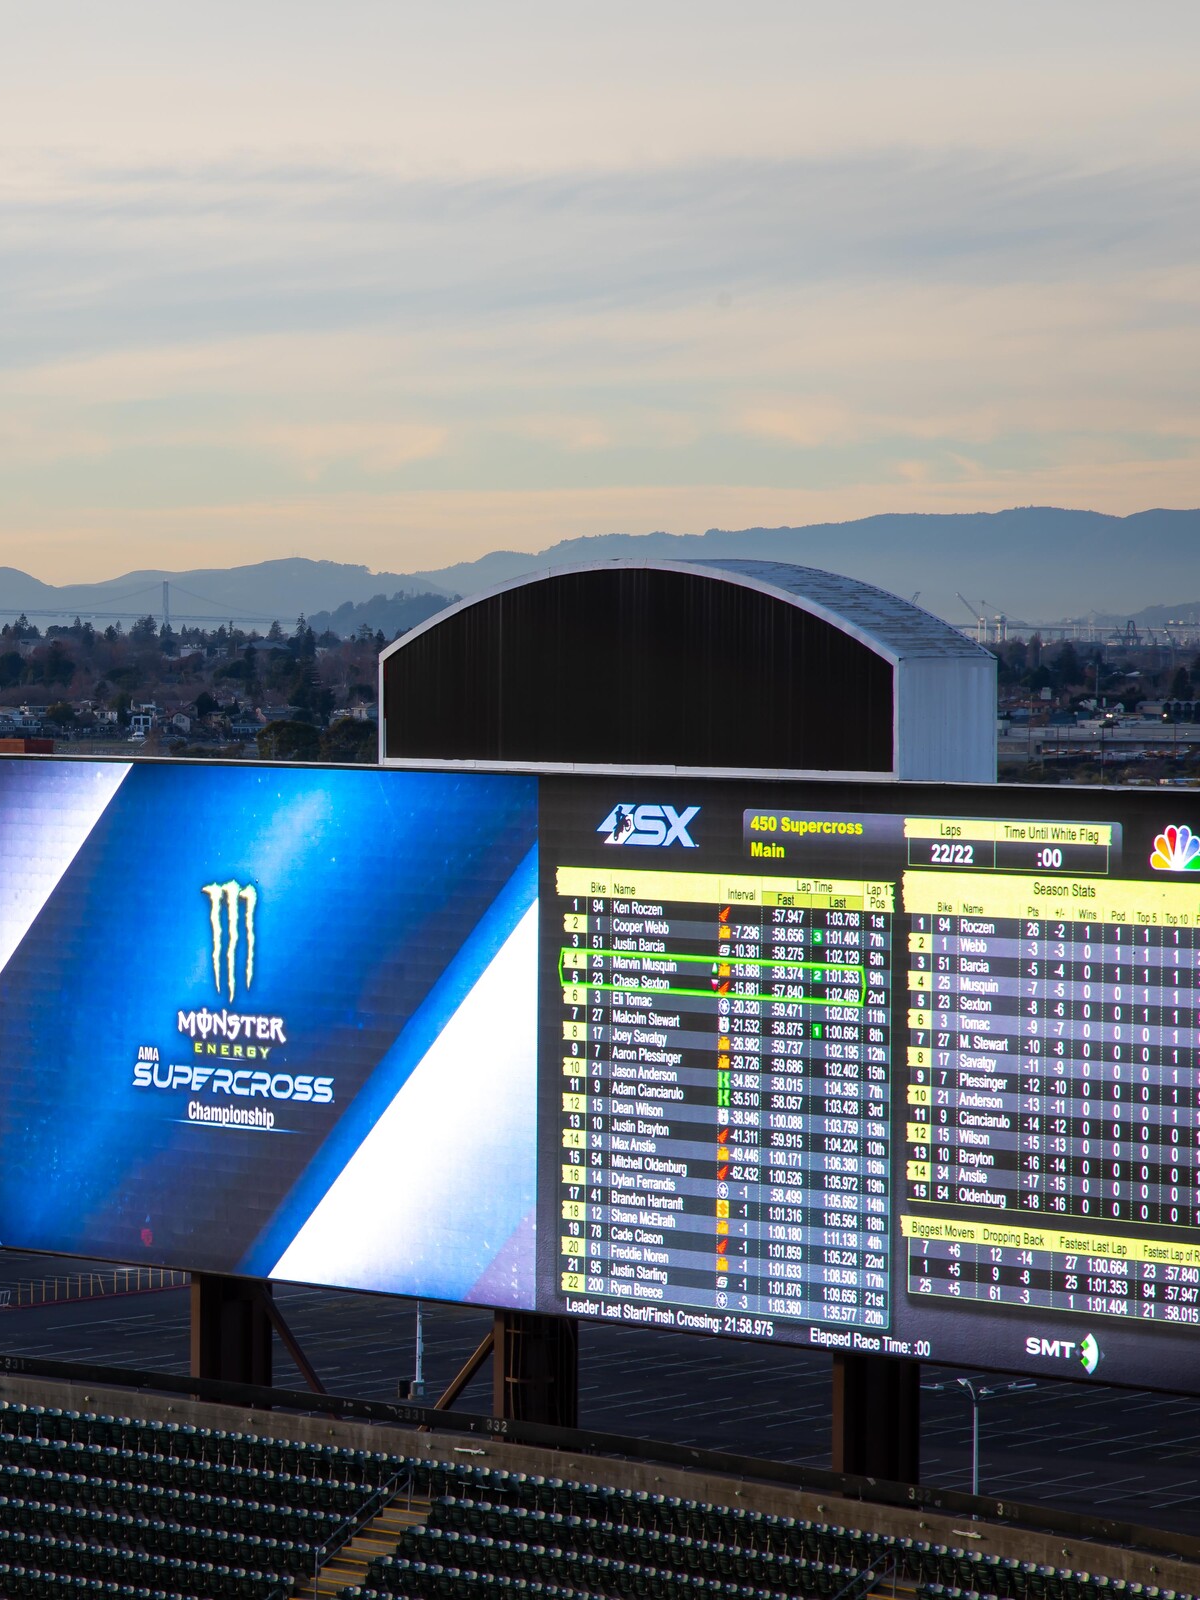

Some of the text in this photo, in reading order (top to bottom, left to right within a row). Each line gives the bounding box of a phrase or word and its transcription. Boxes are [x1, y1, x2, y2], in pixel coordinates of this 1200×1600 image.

[751, 816, 863, 835] 450 Supercross
[941, 823, 961, 838] Laps
[1005, 826, 1099, 844] Time Until White Flag
[751, 842, 785, 858] Main
[931, 844, 973, 863] 22/22
[1037, 849, 1062, 867] :00
[591, 882, 606, 894] Bike
[614, 883, 636, 895] Name
[728, 888, 755, 901] Interval
[797, 880, 832, 894] Lap Time
[867, 884, 881, 896] Lap
[1034, 882, 1096, 897] Season Stats
[614, 901, 662, 915] Ken Roczen
[777, 894, 794, 906] Fast
[829, 896, 846, 908] Last
[870, 897, 885, 909] Pos
[938, 902, 952, 913] Bike
[773, 909, 804, 923] :57.947
[963, 904, 983, 914] Name
[1028, 907, 1039, 917] Pts
[1079, 909, 1097, 920] Wins
[1112, 911, 1125, 921] Pod
[1137, 912, 1158, 924] Top 5
[1165, 914, 1178, 926] Top
[1180, 914, 1188, 925] 10
[613, 918, 669, 935] Cooper Webb
[961, 919, 994, 934] Roczen
[613, 937, 664, 952] Justin Barcia
[826, 931, 859, 945] 1:01.404
[960, 938, 986, 952] Webb
[772, 946, 803, 960] :58.275
[613, 956, 676, 974] Marvin Musquin
[960, 958, 989, 972] Barcia
[613, 974, 669, 992] Chase Sexton
[826, 970, 859, 984] 1:01.353
[772, 984, 803, 1001] :57.840
[960, 977, 998, 994] Musquin
[613, 992, 652, 1007] Eli Tomac
[960, 996, 991, 1011] Sexton
[613, 1010, 679, 1027] Malcolm Stewart
[825, 1006, 858, 1022] 1:02.052
[178, 1008, 286, 1044] MONSTER
[772, 1022, 803, 1036] :58.875
[960, 1015, 990, 1030] Tomac
[612, 1028, 667, 1047] Joey Savatgy
[960, 1034, 1008, 1051] M. Stewart
[138, 1047, 159, 1061] AMA
[194, 1043, 272, 1059] ENERGY
[612, 1046, 682, 1066] Aaron Plessinger
[825, 1044, 858, 1059] 1:02.195
[772, 1058, 802, 1073] :59.686
[960, 1054, 996, 1072] Savatgy
[612, 1064, 677, 1081] Jason Anderson
[132, 1062, 335, 1103] SUPERCROSS
[825, 1081, 858, 1096] 1:04.395
[960, 1073, 1007, 1092] Plessinger
[612, 1082, 683, 1100] Adam Cianciarulo
[612, 1100, 663, 1116] Dean Wilson
[771, 1095, 802, 1109] :58.057
[959, 1092, 1002, 1108] Anderson
[188, 1101, 274, 1127] Championship
[960, 1111, 1010, 1128] Cianciarulo
[612, 1118, 668, 1138] Justin Brayton
[824, 1119, 860, 1136] 1:03.759
[612, 1136, 656, 1152] Max Anstie
[771, 1133, 802, 1148] :59.915
[959, 1130, 989, 1145] Wilson
[612, 1154, 686, 1177] Mitchell Oldenburg
[960, 1149, 994, 1167] Brayton
[612, 1172, 675, 1191] Dylan Ferrandis
[769, 1170, 802, 1185] 1:00.526
[959, 1168, 987, 1183] Anstie
[612, 1190, 683, 1210] Brandon Hartranft
[959, 1187, 1006, 1208] Oldenburg
[611, 1209, 675, 1227] Shane McElrath
[769, 1207, 802, 1222] 1:01.316
[611, 1227, 663, 1244] Cade Clason
[912, 1222, 974, 1239] Biggest Movers
[984, 1229, 1044, 1246] Dropping Back
[611, 1244, 668, 1263] Freddie Noren
[769, 1244, 801, 1260] 1:01.859
[1060, 1236, 1127, 1256] Fastest Last Lap
[1144, 1245, 1169, 1259] Fastest
[1171, 1247, 1183, 1262] Lap
[1186, 1249, 1193, 1261] of
[611, 1263, 667, 1284] Justin Starling
[1087, 1258, 1128, 1276] 1:00.664
[1165, 1266, 1199, 1284] :57.840
[611, 1280, 663, 1298] Ryan Breece
[768, 1281, 801, 1297] 1:01.876
[1087, 1278, 1128, 1295] 1:01.353
[1165, 1285, 1199, 1303] :57.947
[1087, 1297, 1128, 1315] 1:01.404
[1165, 1305, 1198, 1323] :58.015
[566, 1298, 599, 1316] Leader
[601, 1301, 622, 1319] Last
[677, 1311, 722, 1333] Crossing:
[724, 1316, 774, 1337] 21:58.975
[810, 1327, 930, 1357] Elapsed Race Time: :00
[1026, 1337, 1076, 1359] SMT
[486, 1418, 507, 1432] 332
